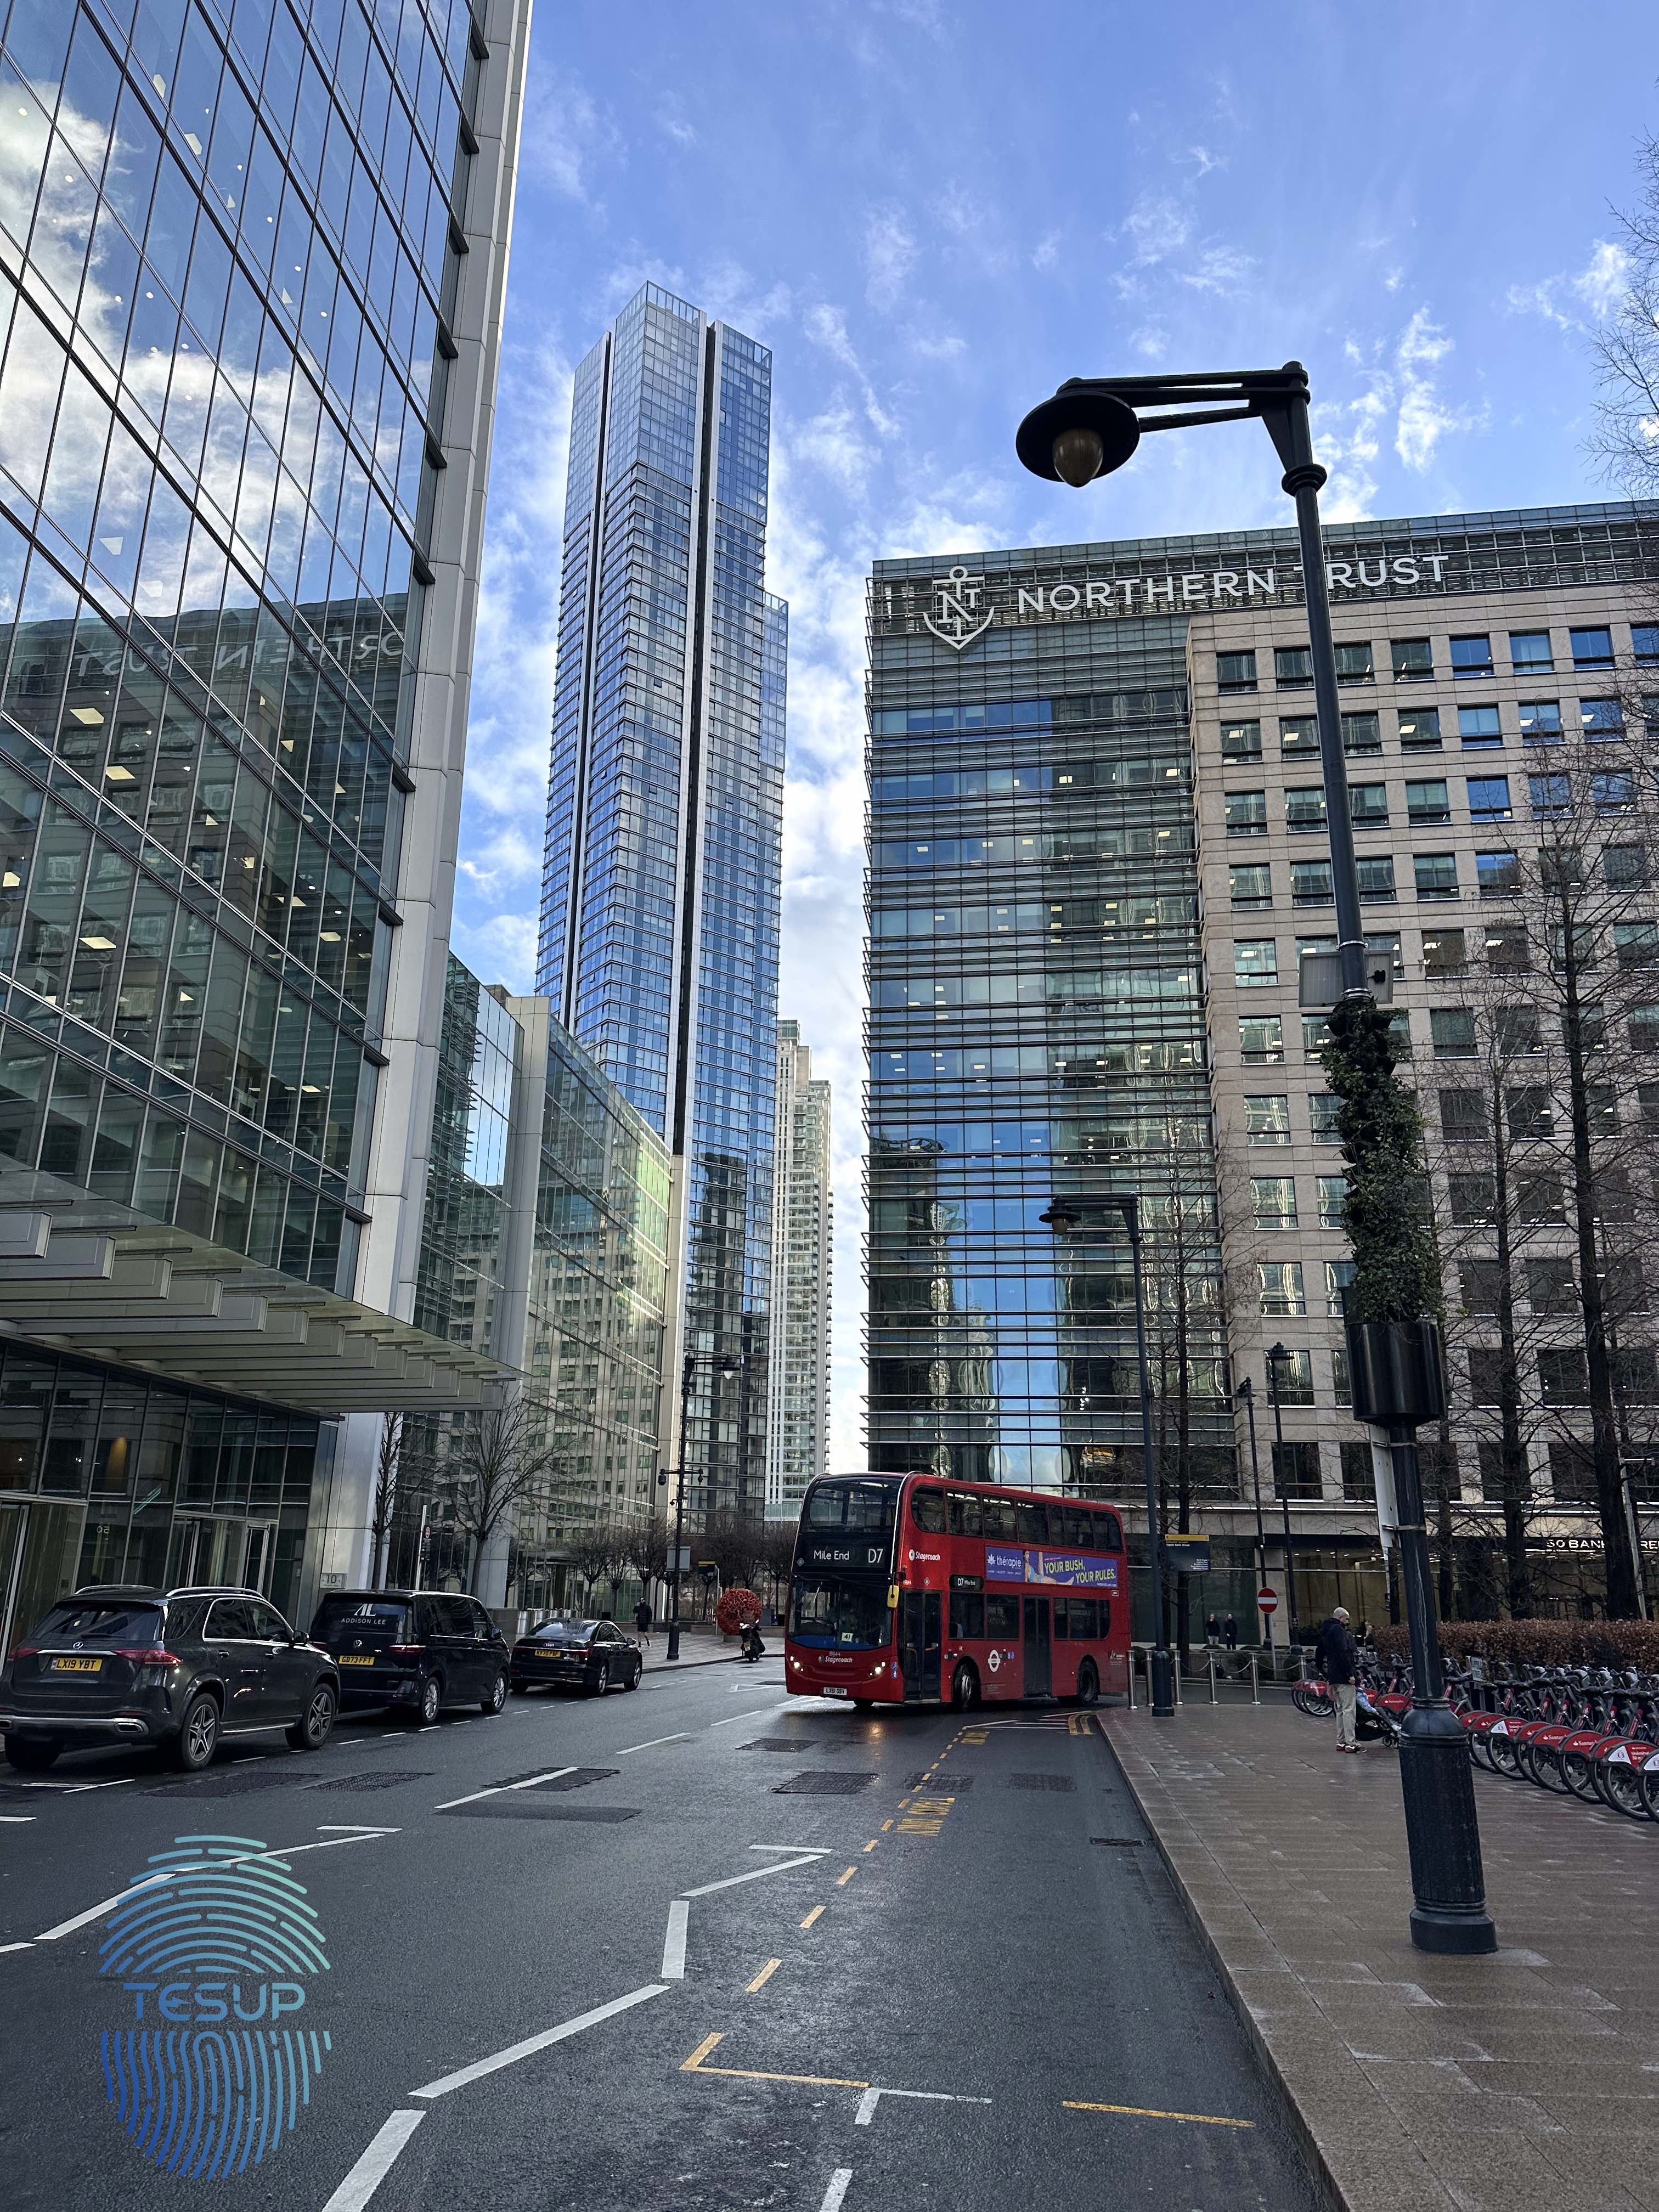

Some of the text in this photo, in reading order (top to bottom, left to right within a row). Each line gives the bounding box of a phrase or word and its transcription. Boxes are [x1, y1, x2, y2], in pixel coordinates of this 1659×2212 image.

[1018, 555, 1449, 614] NORTHERN RUST
[814, 1550, 849, 1560] Mile End
[868, 1548, 883, 1563] D7
[915, 1551, 940, 1562] Stagecoach
[996, 1555, 1021, 1568] thérapie
[1045, 1559, 1085, 1574] YOUR BUSH,
[327, 1573, 337, 1584] 10
[957, 1578, 964, 1586] D7
[1075, 1568, 1116, 1584] YOUR RULES.
[56, 1659, 97, 1669] LX19 YBT
